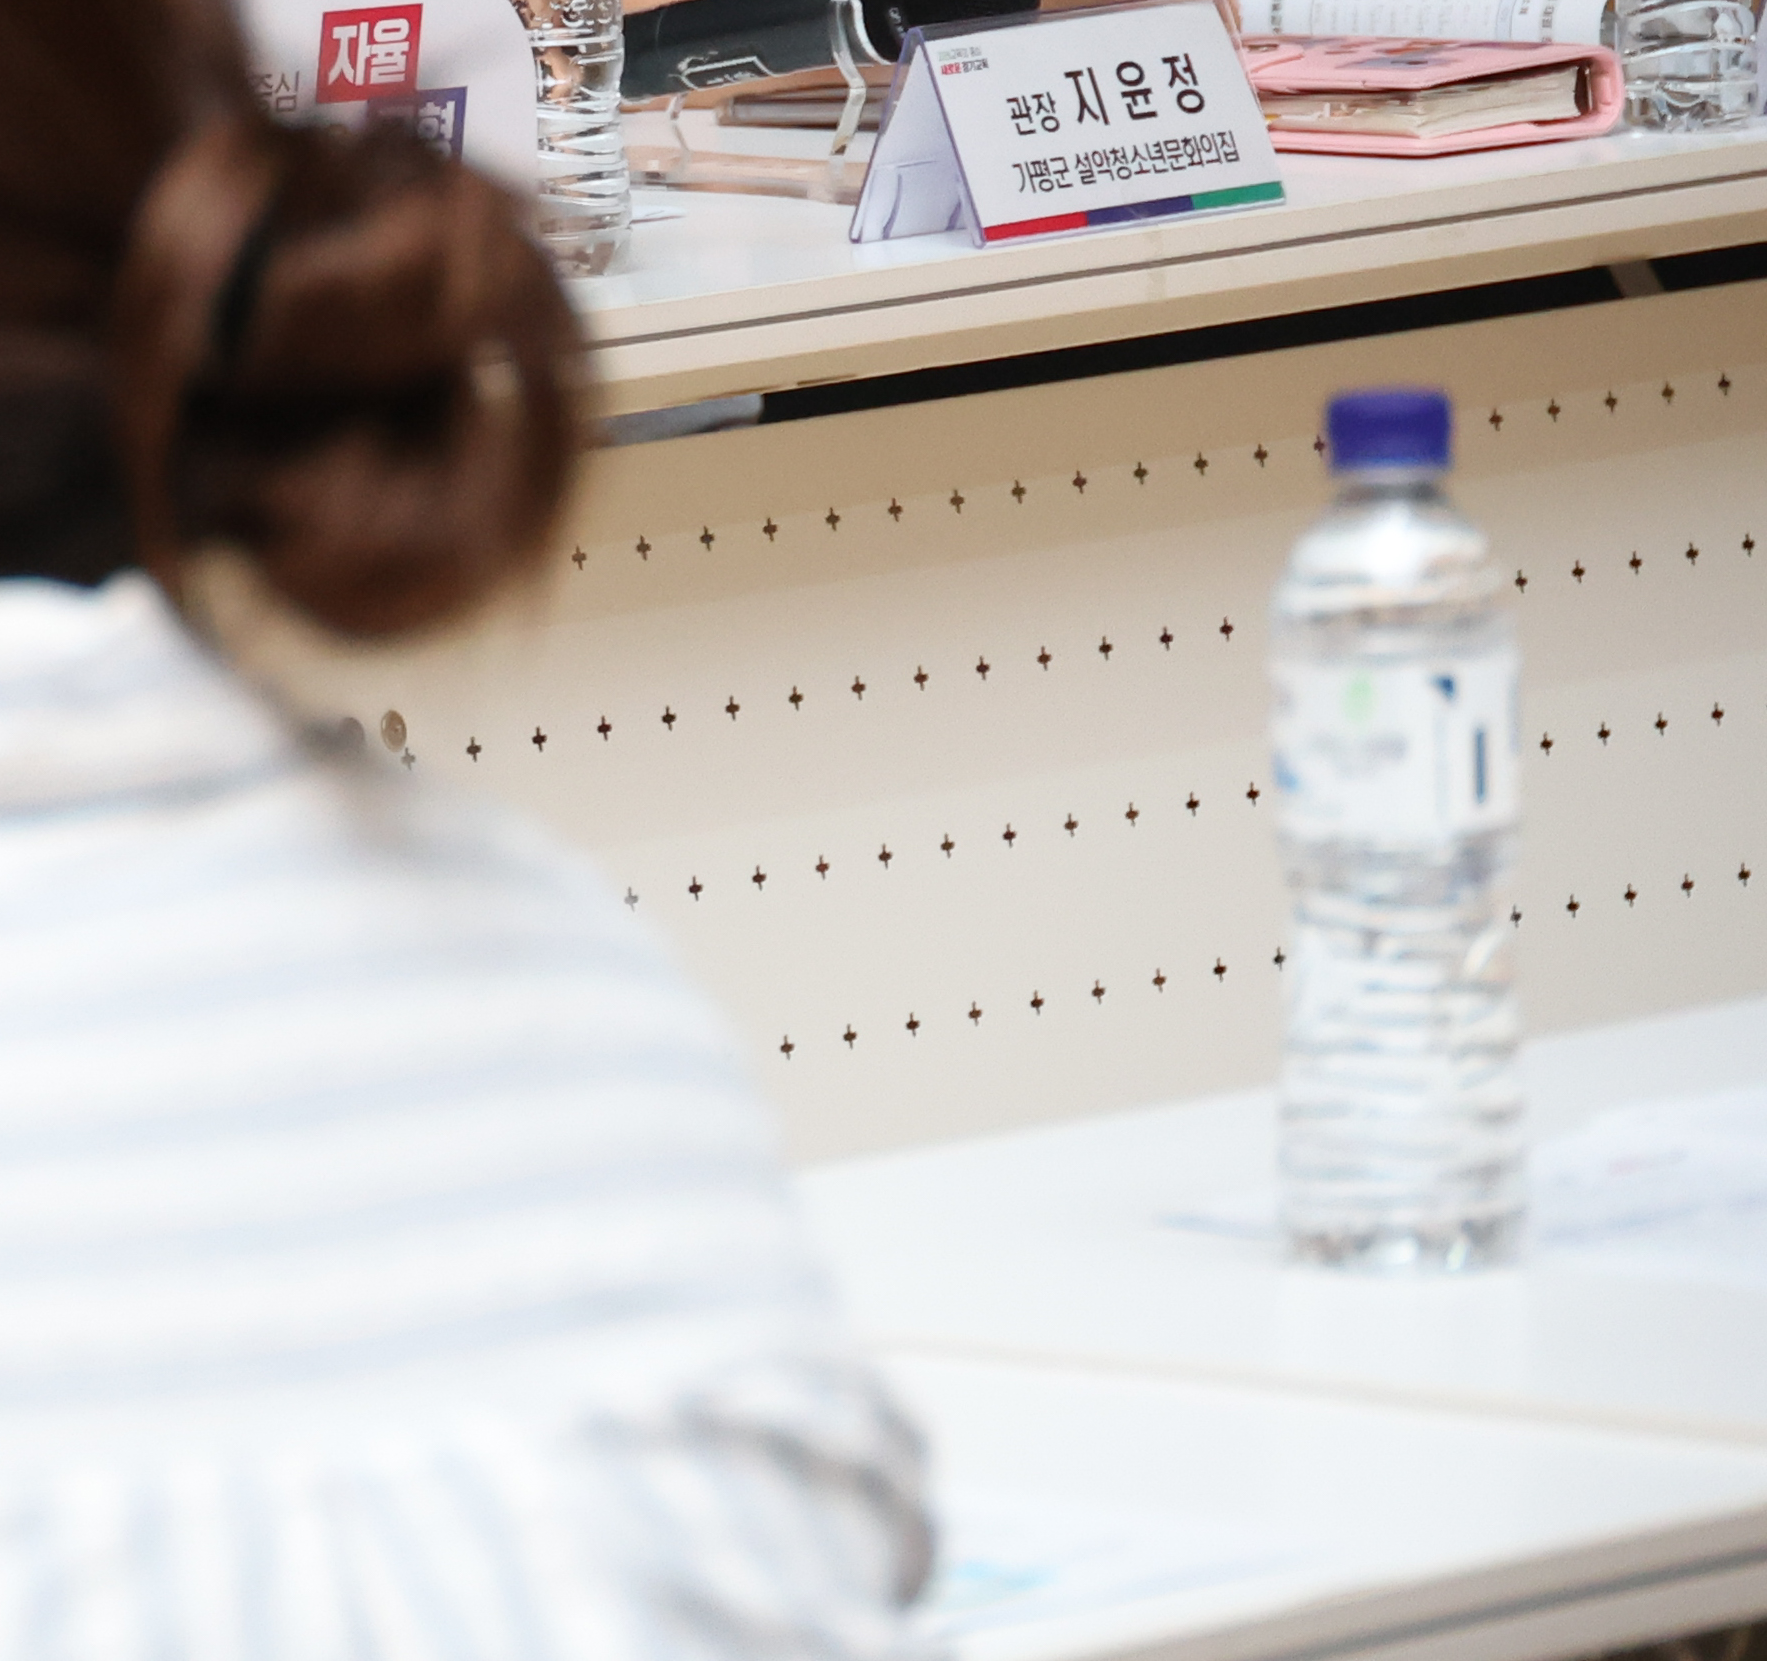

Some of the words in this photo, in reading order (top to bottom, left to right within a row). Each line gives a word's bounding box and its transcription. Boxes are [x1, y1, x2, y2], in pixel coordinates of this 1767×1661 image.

[327, 17, 411, 87] 자율
[1005, 91, 1060, 136] 관장
[1011, 158, 1074, 194] 가평군
[1073, 130, 1240, 187] 설악청소년문화의집
